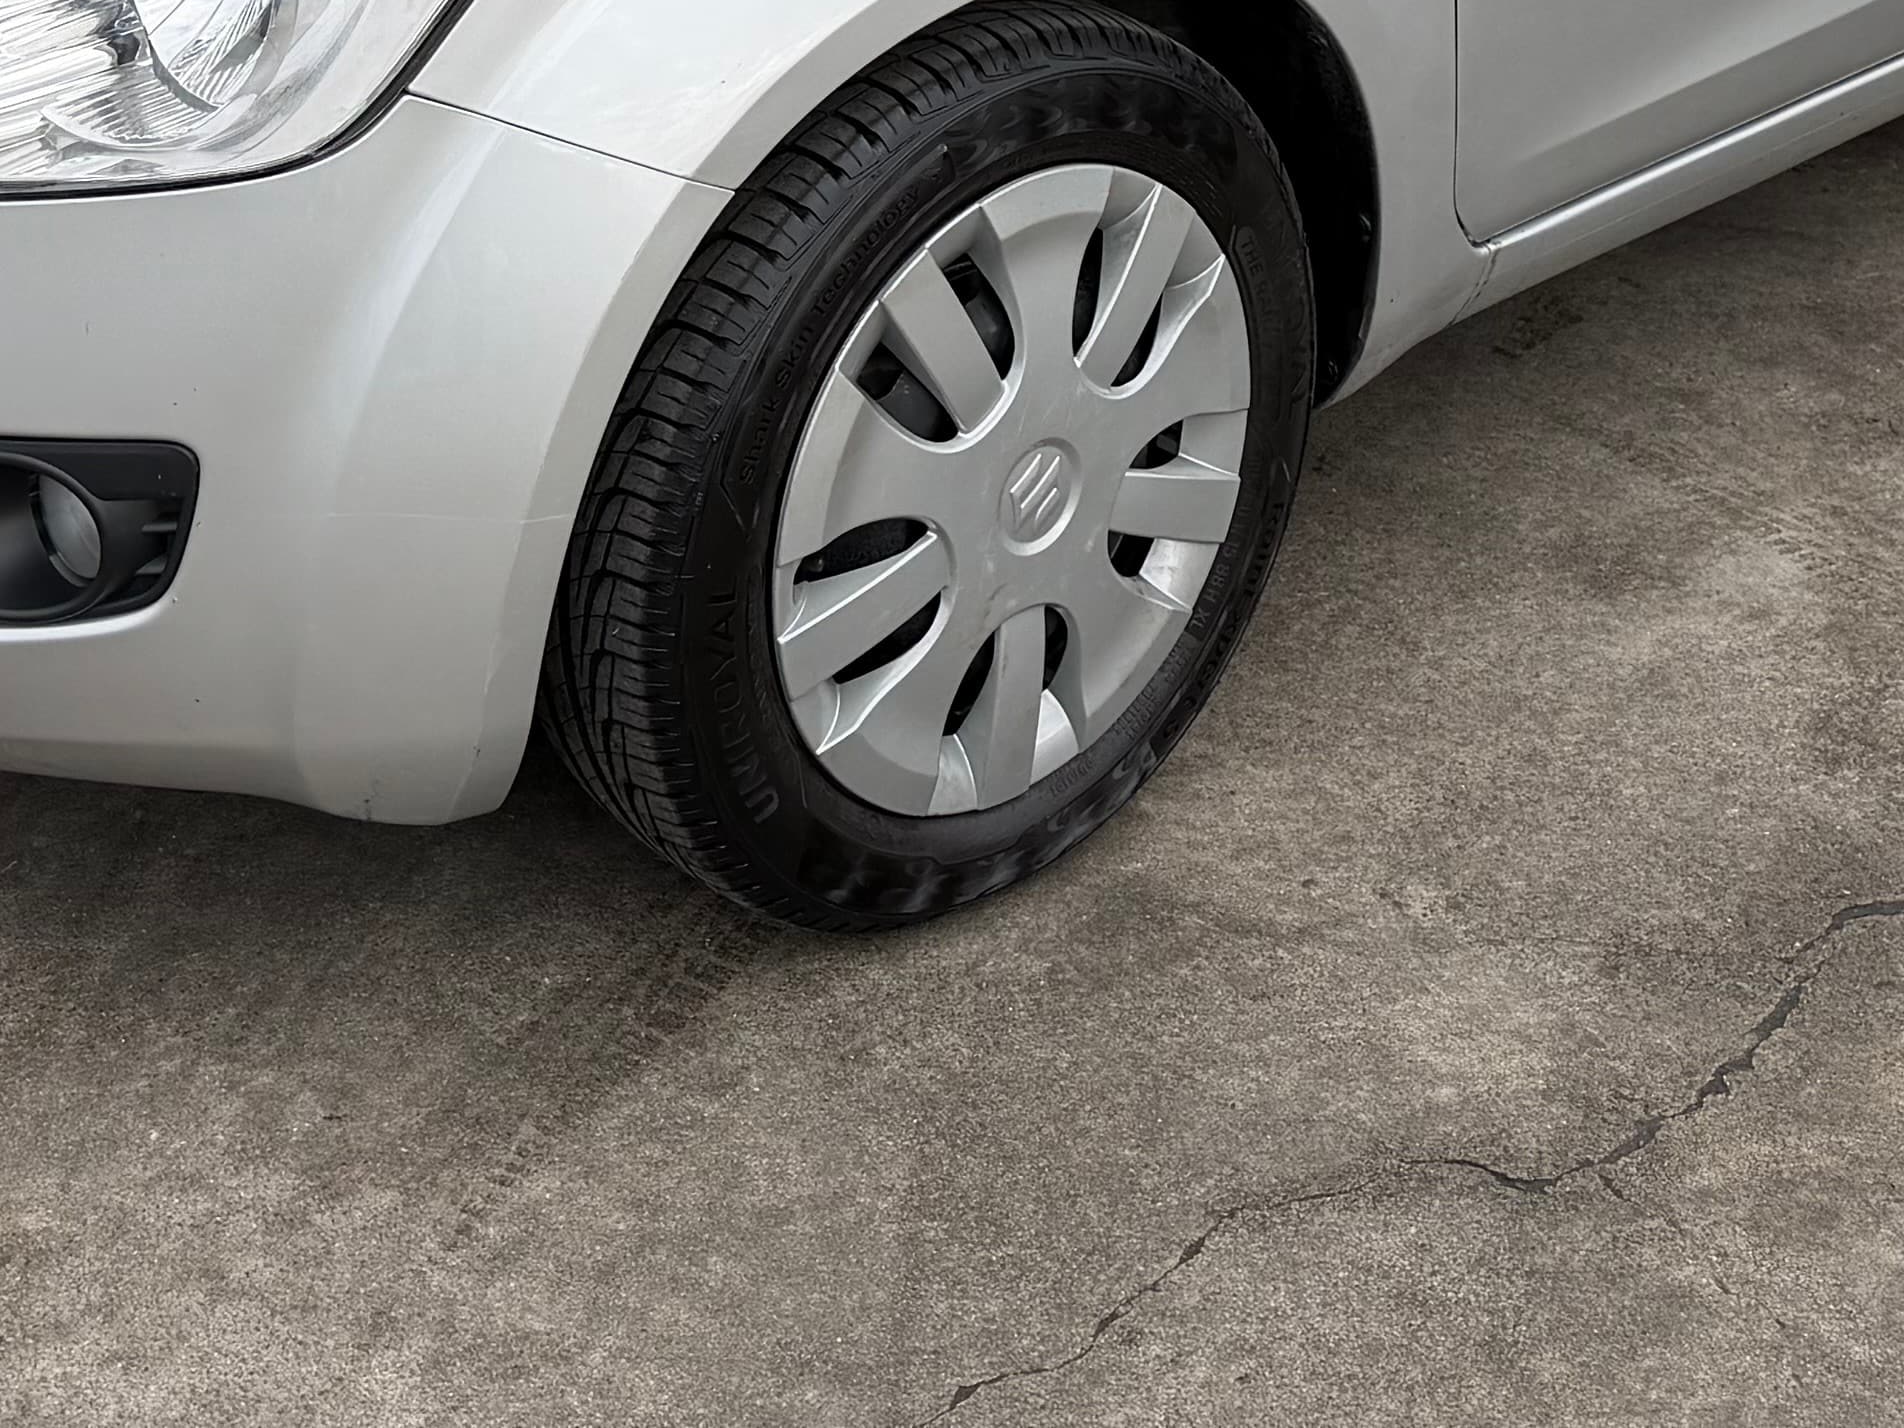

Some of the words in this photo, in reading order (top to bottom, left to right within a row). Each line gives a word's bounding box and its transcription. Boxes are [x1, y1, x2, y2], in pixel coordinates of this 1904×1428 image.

[738, 393, 781, 486] Shark
[774, 326, 816, 391] Skin
[809, 184, 919, 318] Technology
